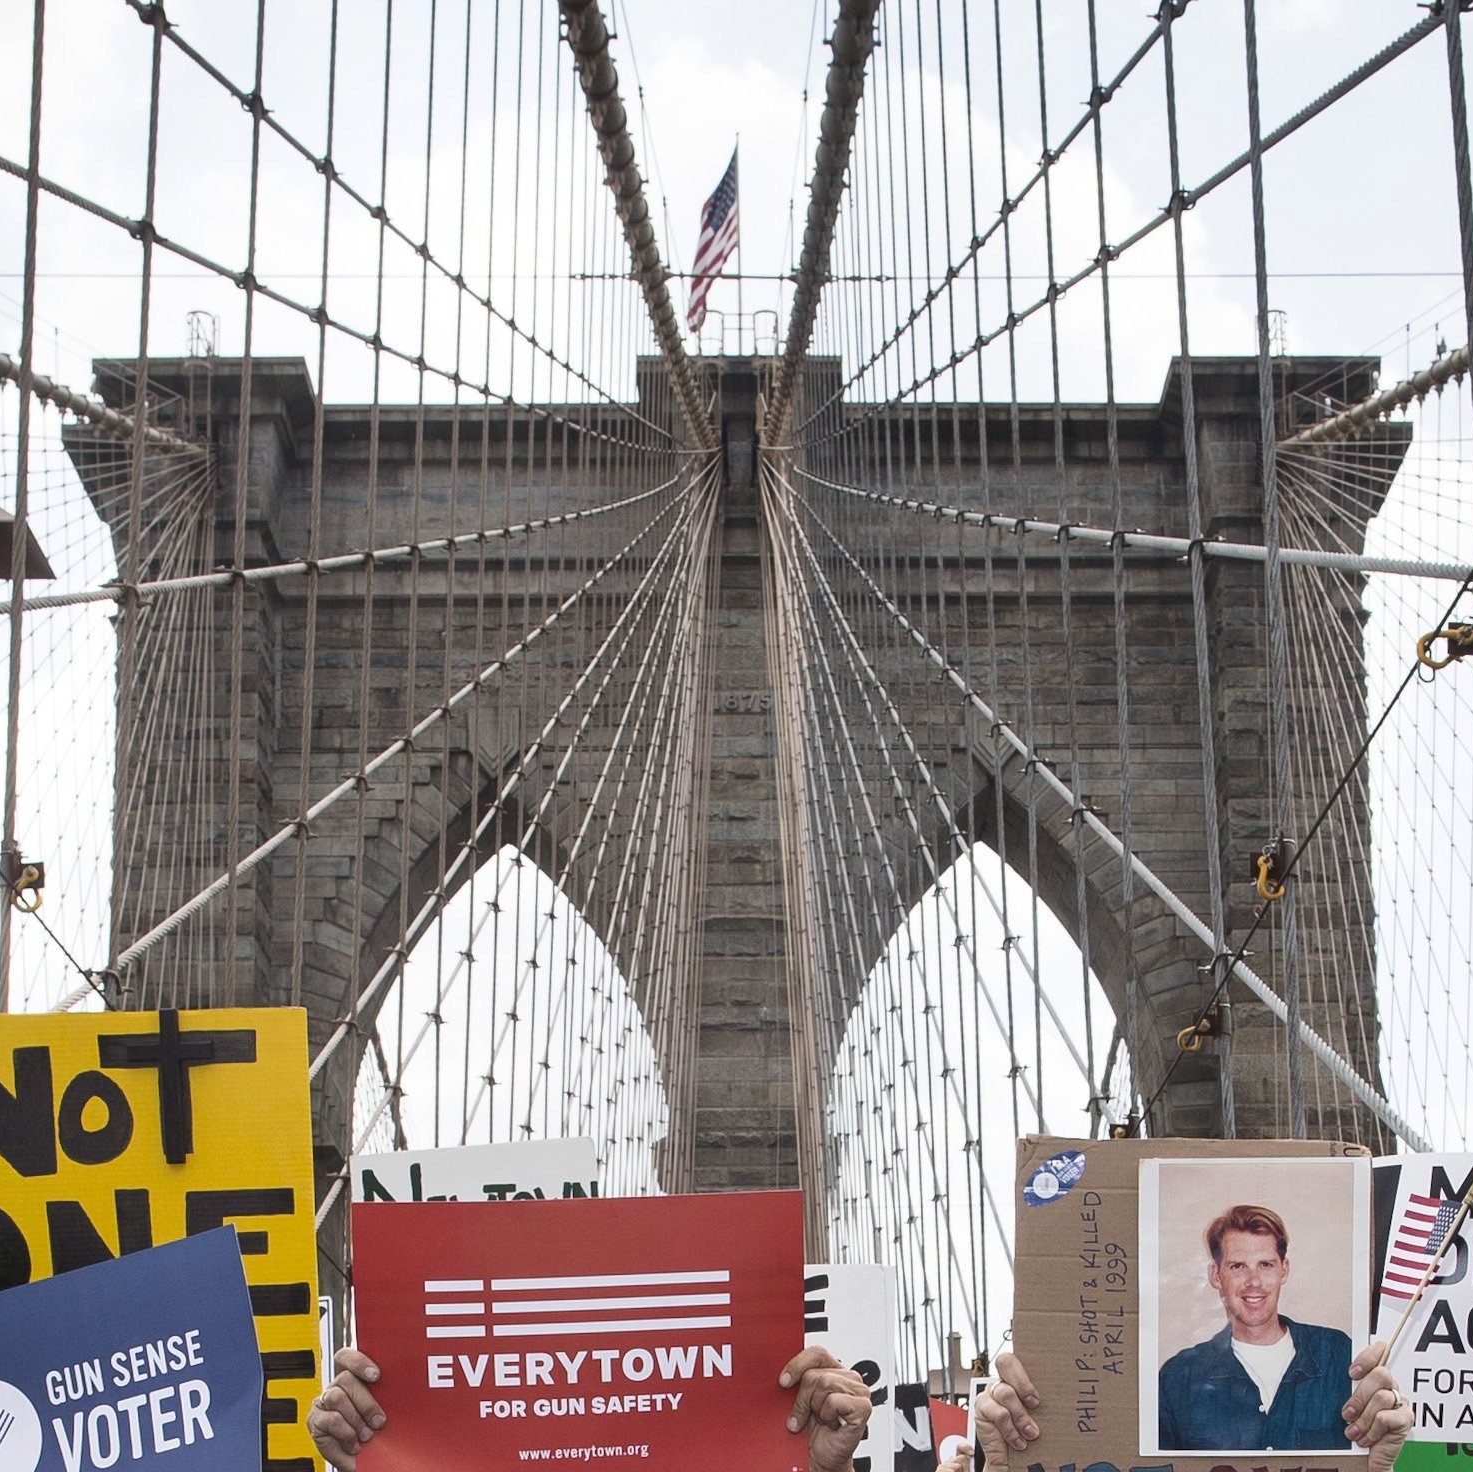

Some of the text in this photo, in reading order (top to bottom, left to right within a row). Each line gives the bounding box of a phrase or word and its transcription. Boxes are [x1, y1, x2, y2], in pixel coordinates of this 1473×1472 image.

[1077, 1190, 1102, 1269] KILLED
[1083, 1278, 1097, 1289] &
[1080, 1295, 1100, 1345] SHOT
[1103, 1243, 1127, 1375] APRIL 1999
[45, 1329, 205, 1406] GUN SENSE
[427, 1344, 733, 1389] EVERYTOWN
[479, 1392, 683, 1419] FOR GUN SAFETY
[518, 1443, 649, 1461] www.everytown.org
